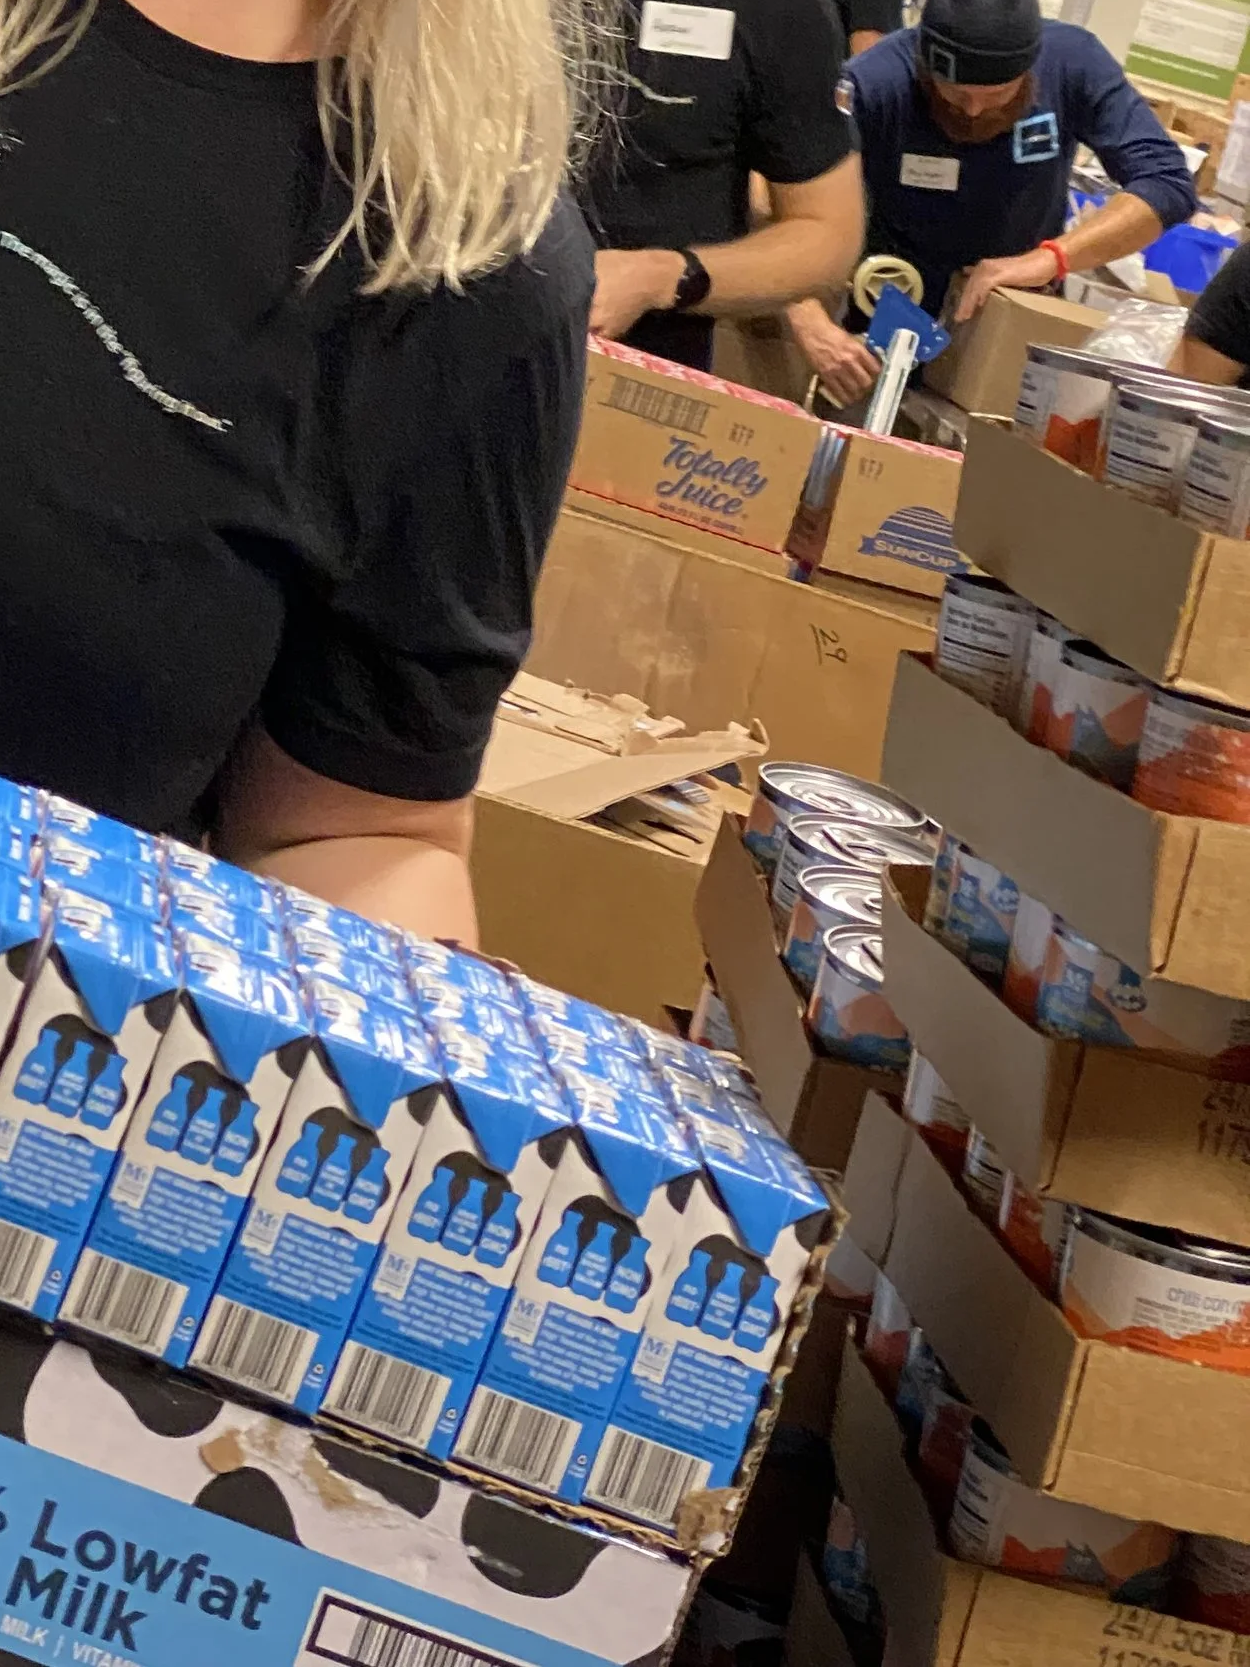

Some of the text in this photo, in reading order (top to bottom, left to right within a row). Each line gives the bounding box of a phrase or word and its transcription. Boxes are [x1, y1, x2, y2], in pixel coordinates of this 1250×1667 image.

[655, 471, 743, 515] Juice
[663, 435, 768, 496] Totally
[30, 1498, 271, 1631] Lowfat
[0, 1614, 50, 1647] MILK
[5, 1555, 148, 1652] Milk
